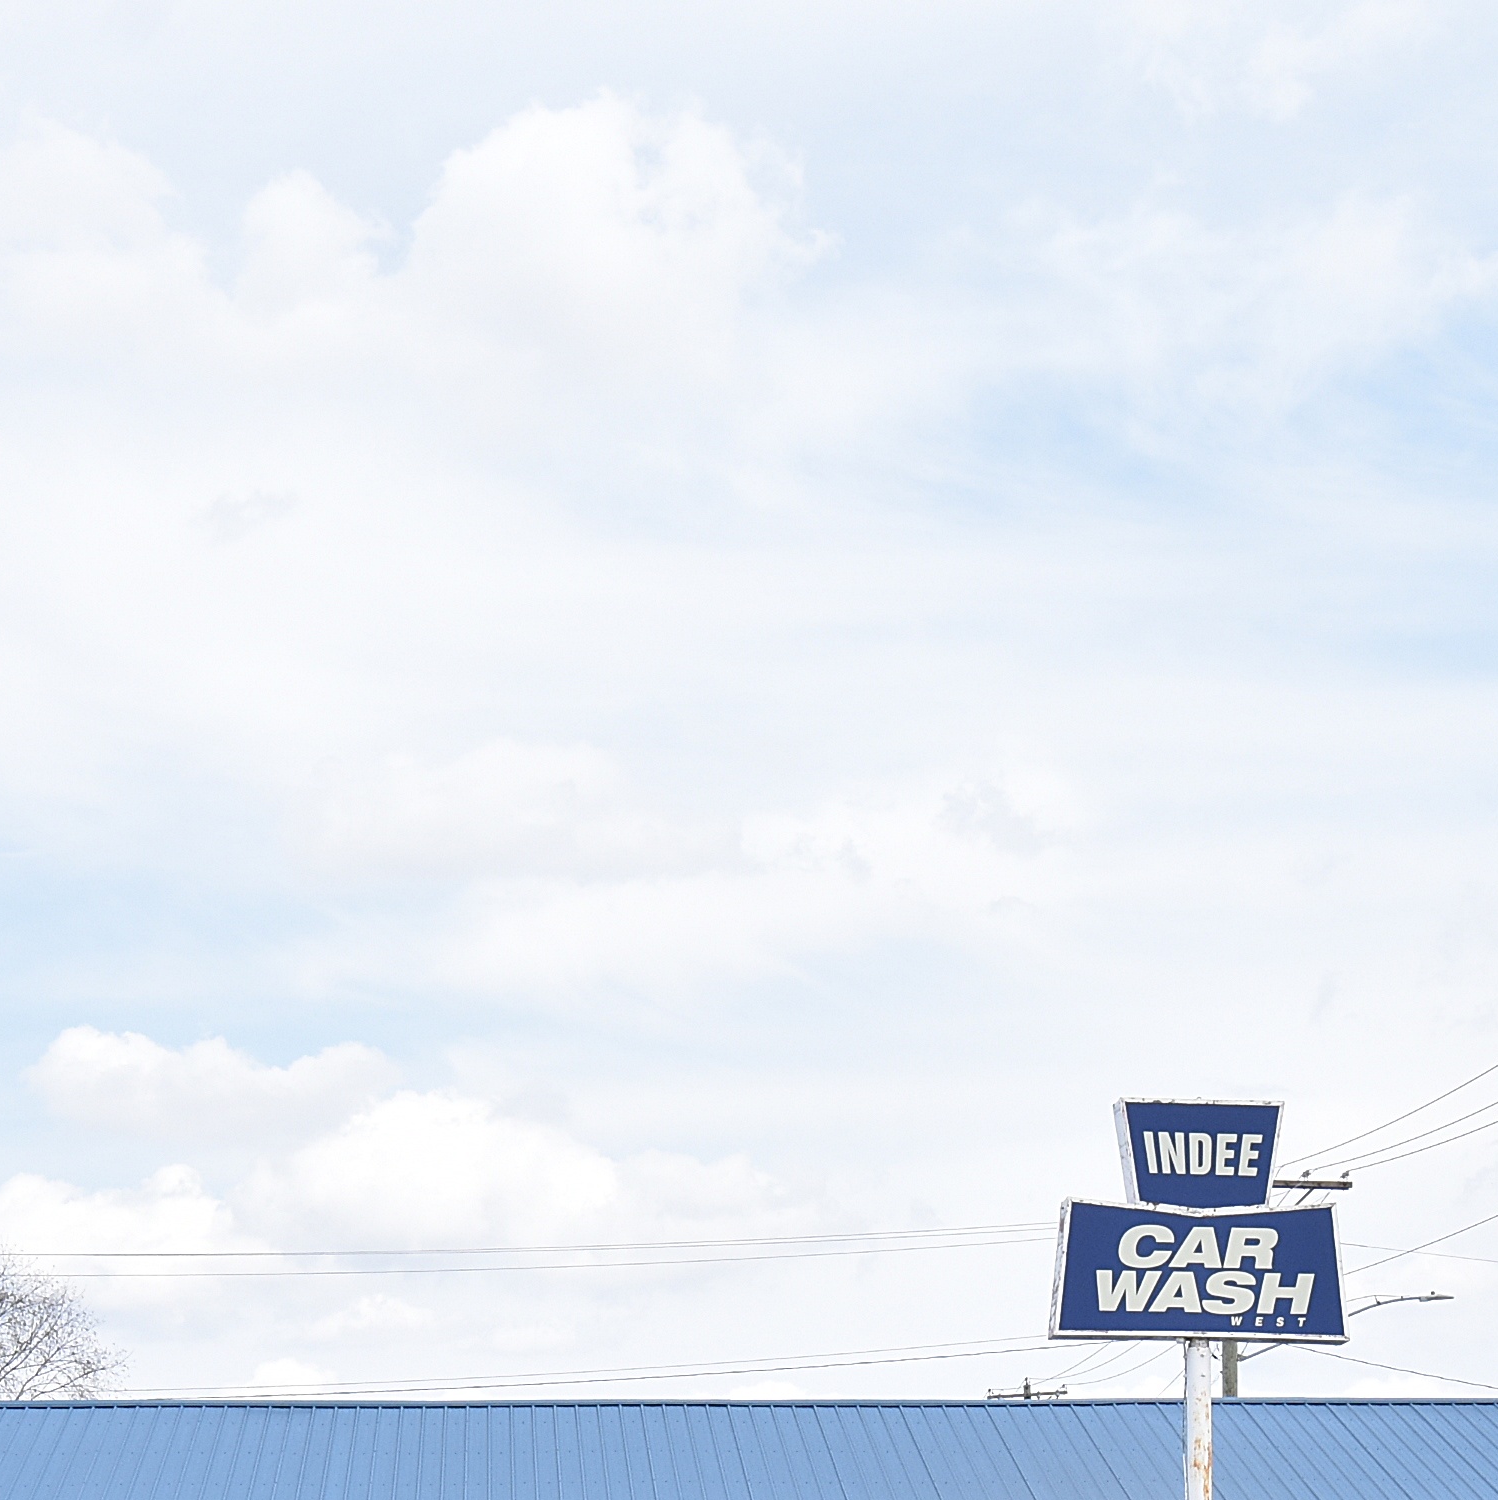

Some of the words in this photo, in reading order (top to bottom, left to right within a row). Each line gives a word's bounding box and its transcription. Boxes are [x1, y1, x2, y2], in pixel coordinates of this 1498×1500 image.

[1143, 1131, 1263, 1177] INDEE
[1118, 1224, 1279, 1269] CAR
[1096, 1269, 1315, 1315] WASH
[1231, 1316, 1306, 1327] WEST
